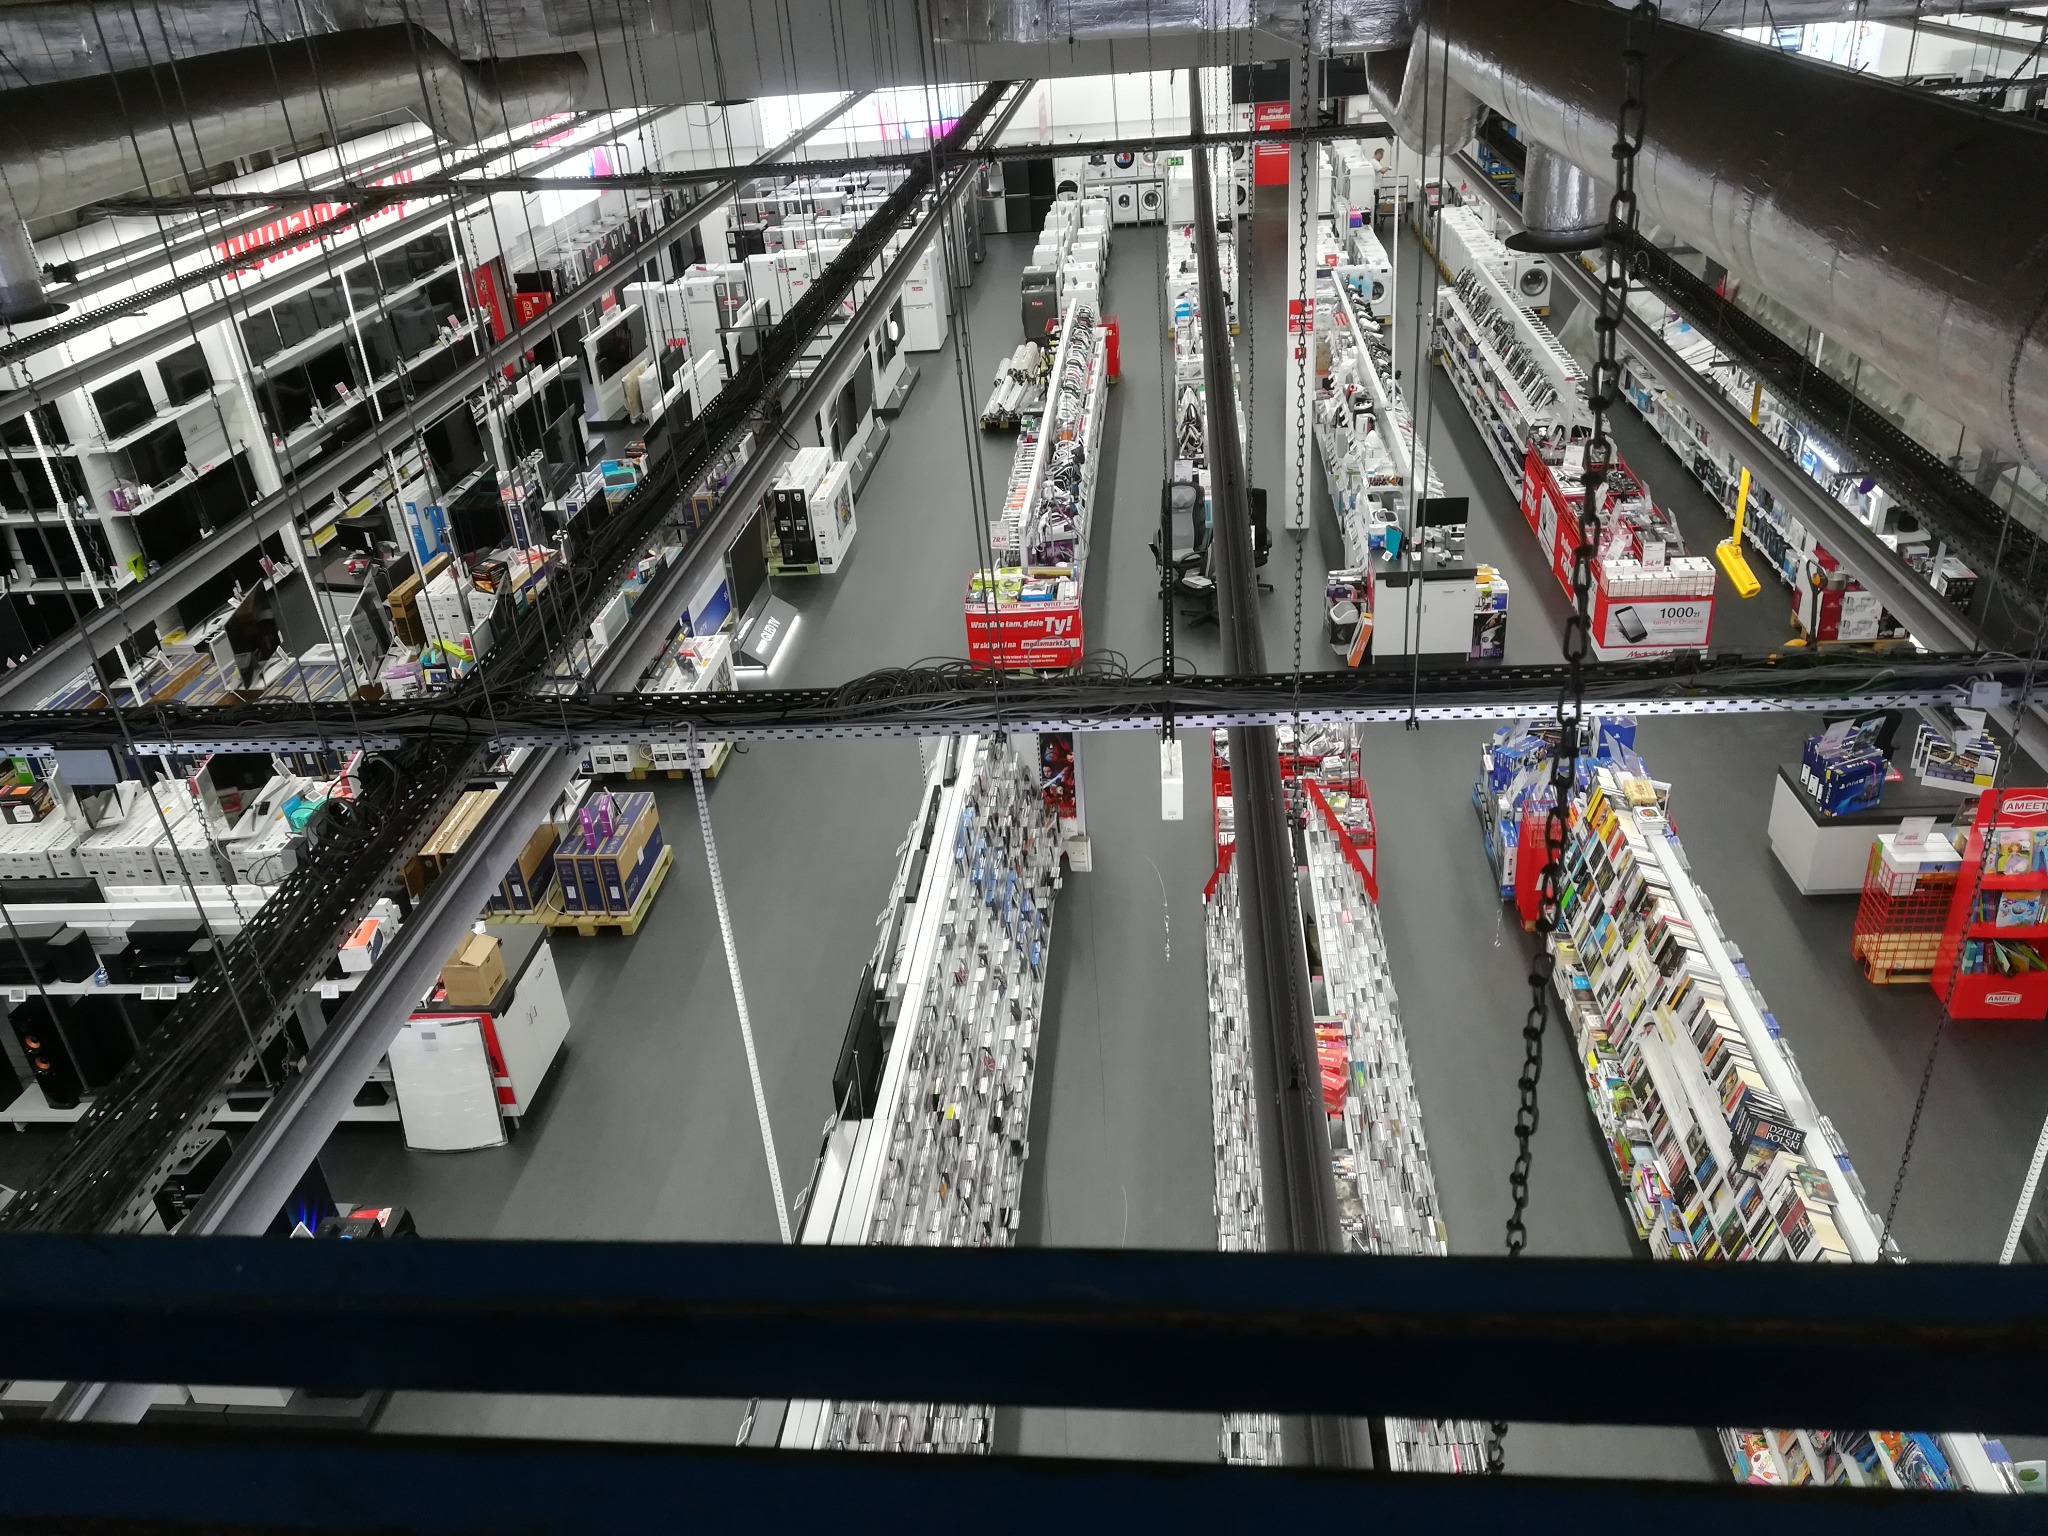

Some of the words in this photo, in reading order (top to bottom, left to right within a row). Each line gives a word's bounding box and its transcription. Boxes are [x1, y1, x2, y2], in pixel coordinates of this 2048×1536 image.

[1023, 619, 1043, 629] gdzie
[1044, 615, 1073, 635] Ty!
[1023, 639, 1071, 647] mediamarkt.pl
[2006, 802, 2047, 811] AMEET
[1765, 1132, 1801, 1150] POLSKI
[1769, 1124, 1802, 1142] DZIEJE
